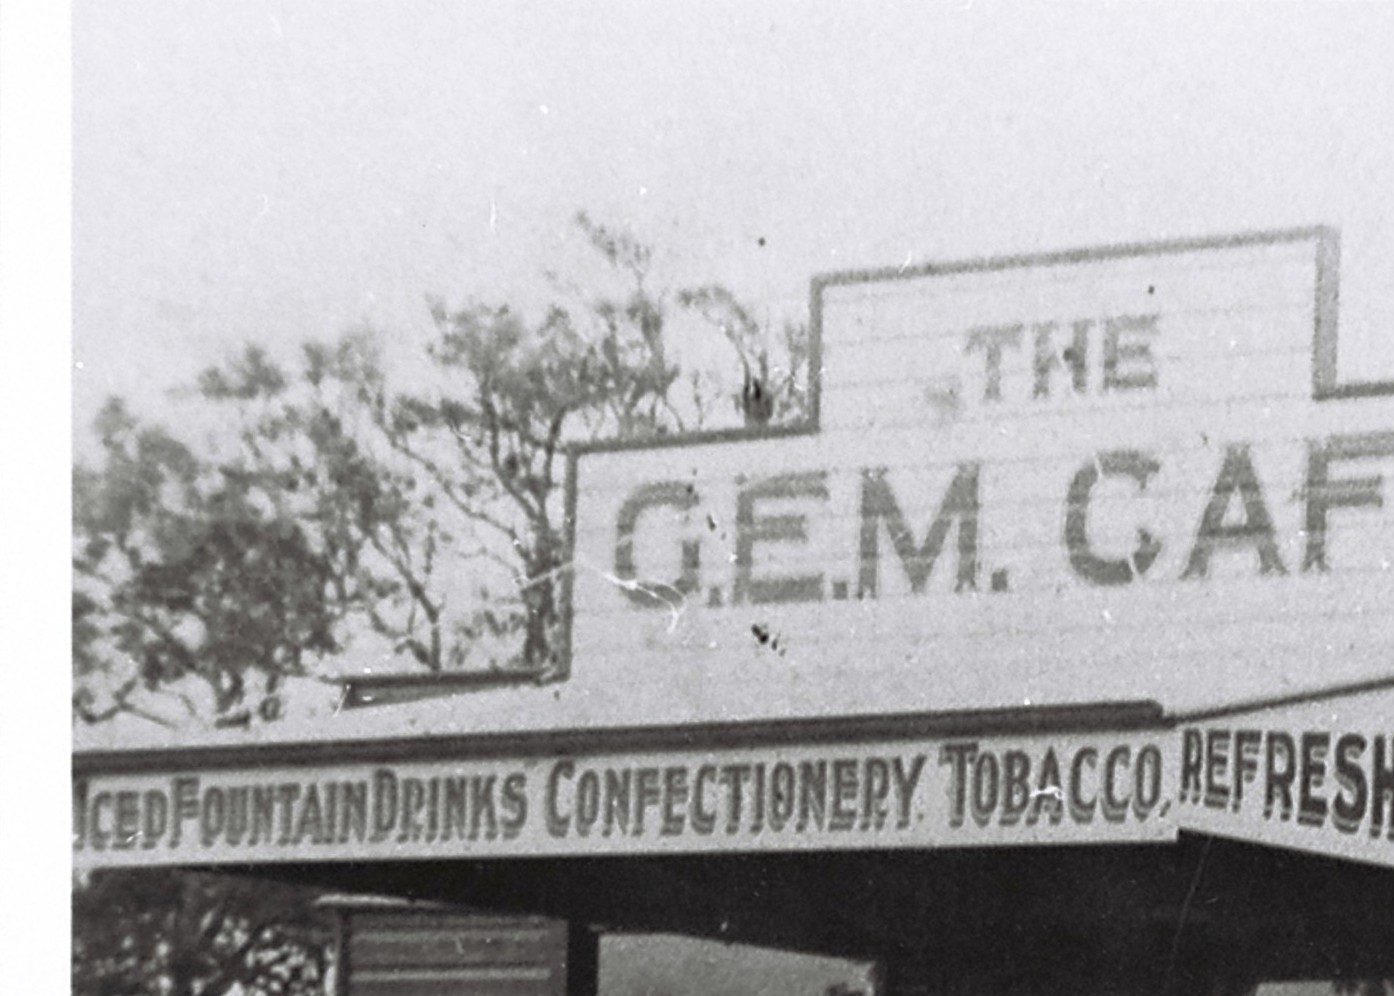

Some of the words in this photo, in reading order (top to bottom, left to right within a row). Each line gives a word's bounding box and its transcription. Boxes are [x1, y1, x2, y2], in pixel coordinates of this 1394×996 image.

[964, 313, 1161, 402] THE
[612, 462, 1010, 608] G.E.M.
[73, 779, 168, 850] ICED
[168, 776, 371, 850] FOUNTAIN
[369, 768, 529, 843] DRINKS
[939, 741, 1171, 829] TOBACCO,
